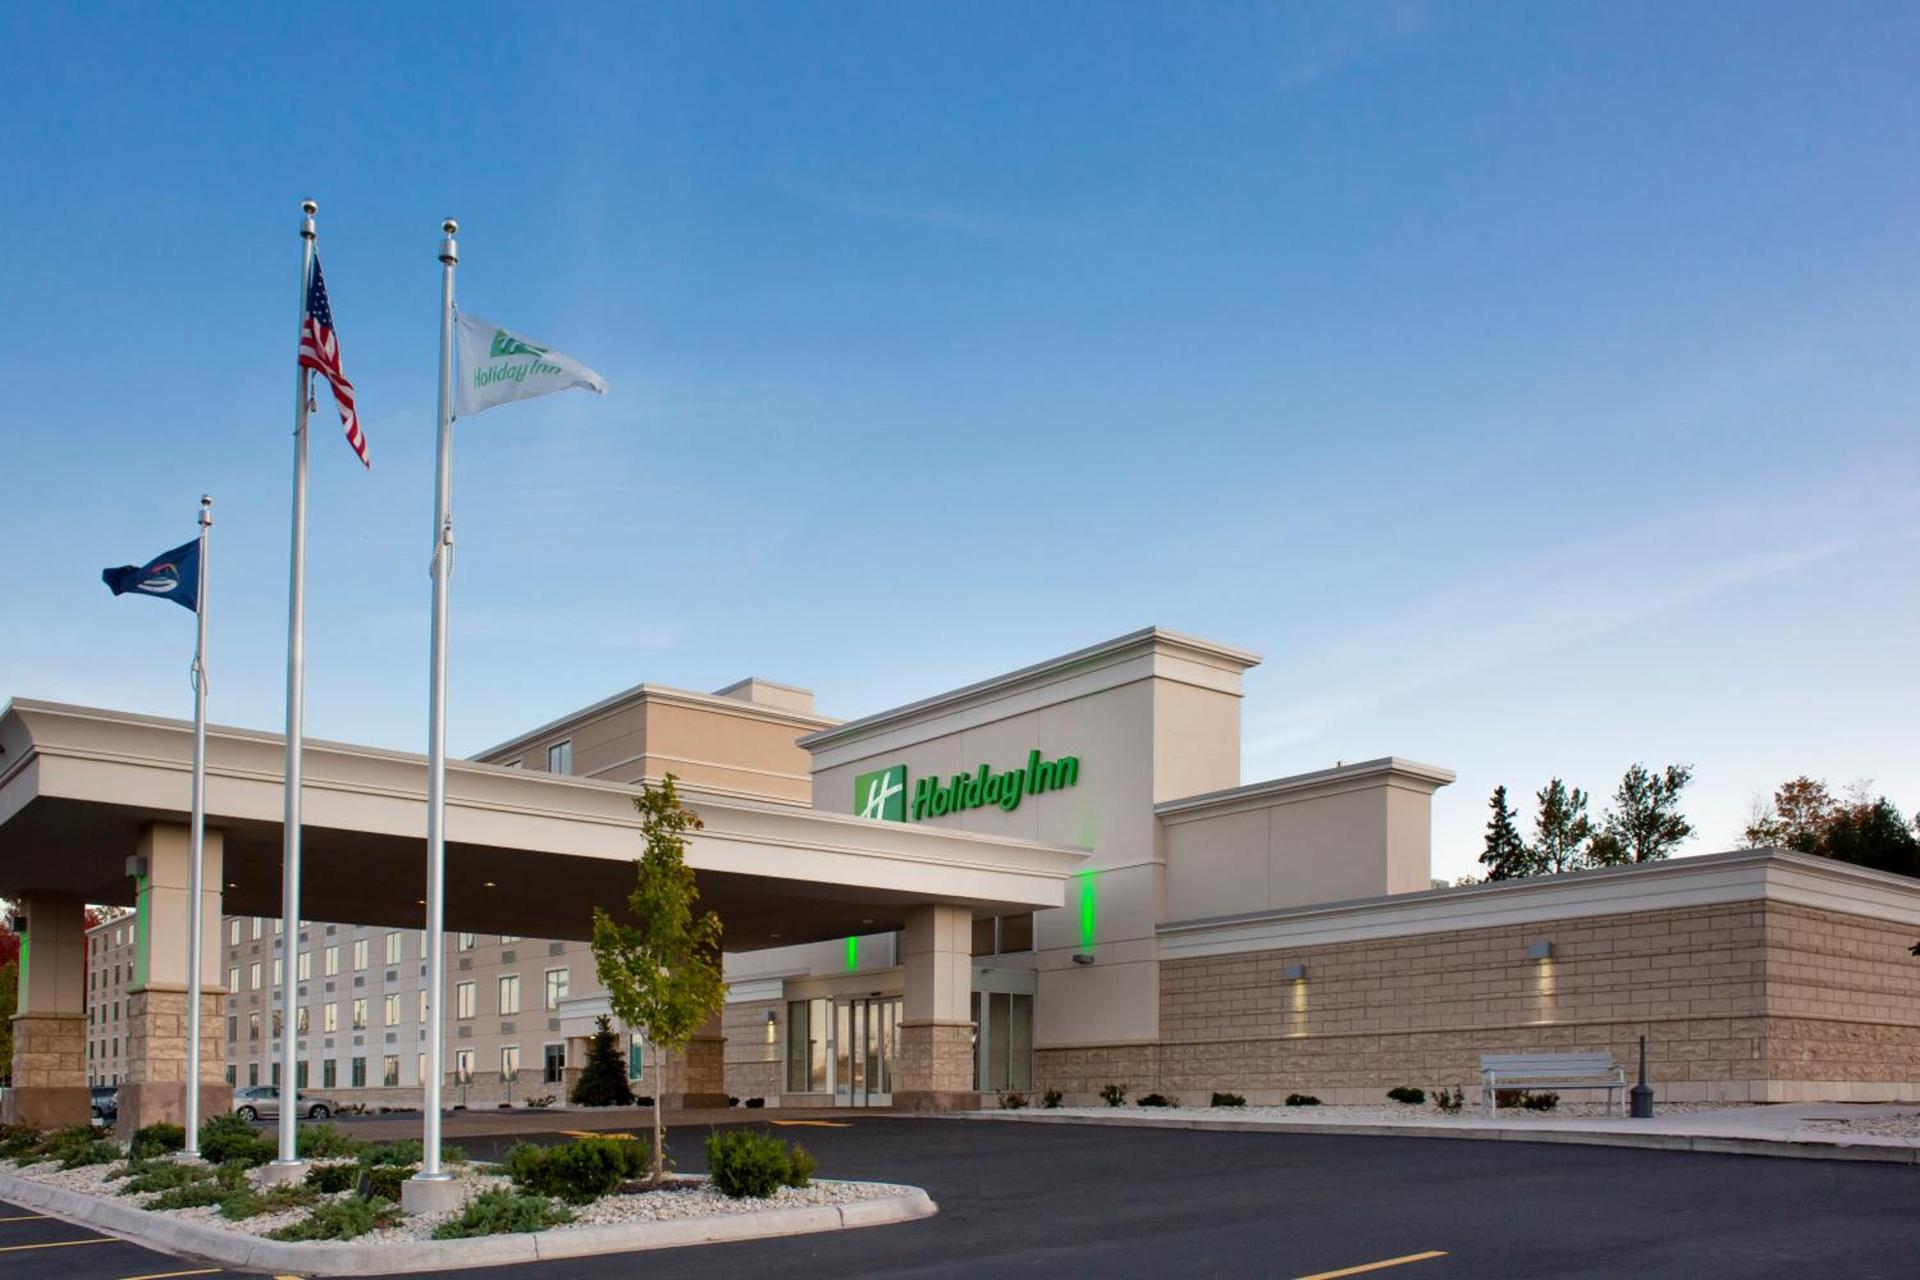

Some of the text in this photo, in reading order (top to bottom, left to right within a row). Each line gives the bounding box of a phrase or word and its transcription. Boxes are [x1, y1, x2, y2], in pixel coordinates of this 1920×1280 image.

[474, 359, 562, 388] Holiday Inn
[912, 750, 1079, 820] Holiday Inn
